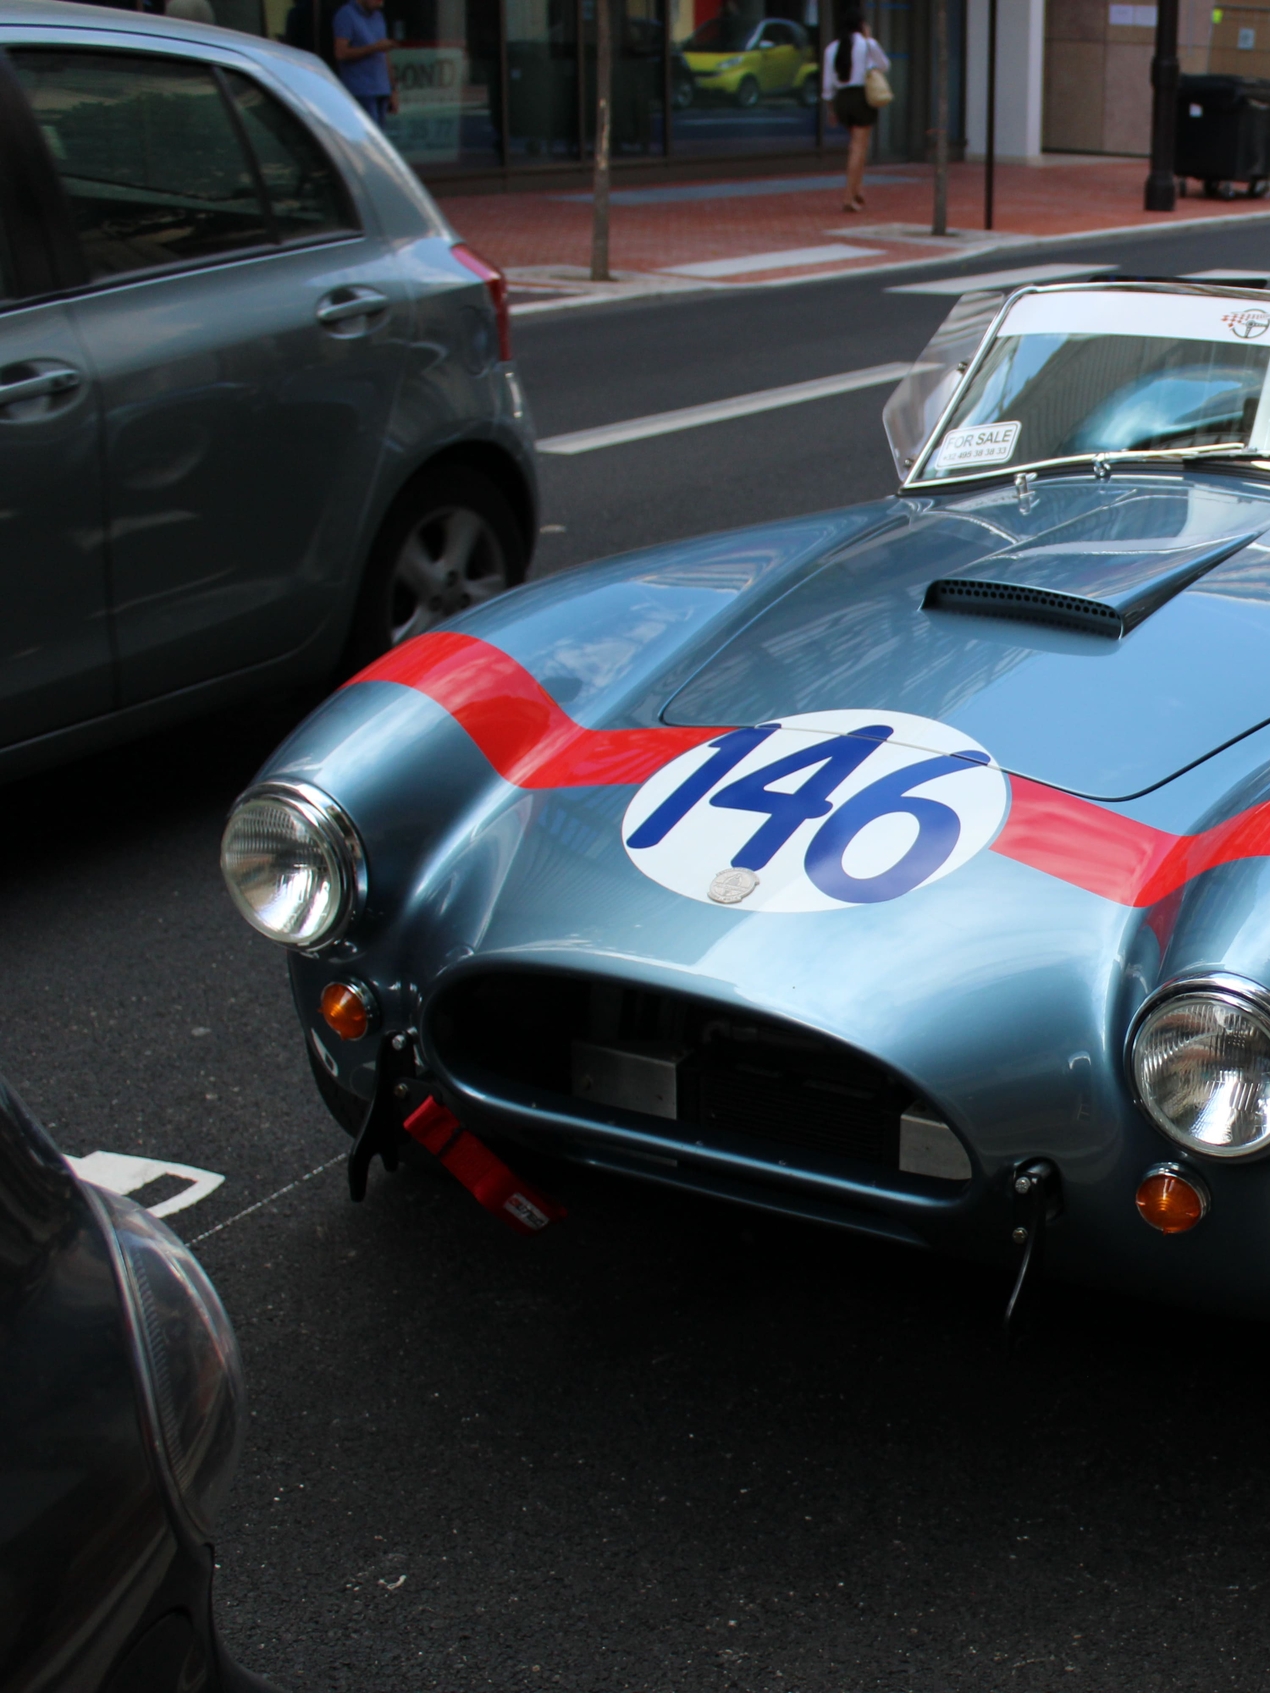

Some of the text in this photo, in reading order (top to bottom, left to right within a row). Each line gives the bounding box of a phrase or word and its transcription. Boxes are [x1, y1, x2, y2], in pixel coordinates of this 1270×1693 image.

[946, 429, 1013, 449] FOR SALE
[625, 723, 991, 904] 146
